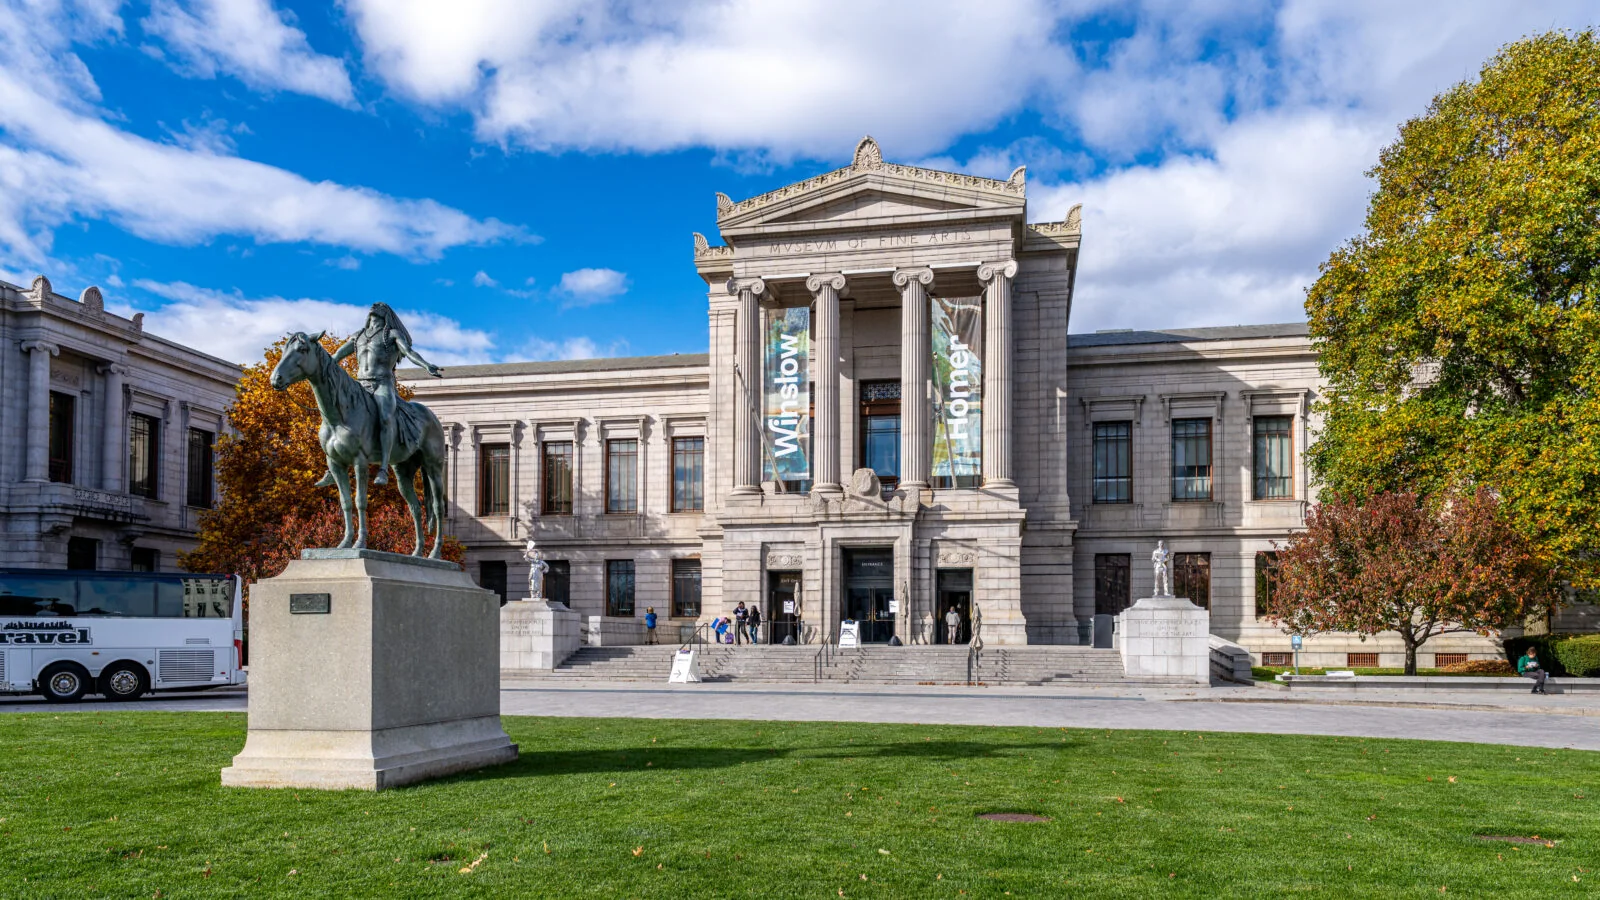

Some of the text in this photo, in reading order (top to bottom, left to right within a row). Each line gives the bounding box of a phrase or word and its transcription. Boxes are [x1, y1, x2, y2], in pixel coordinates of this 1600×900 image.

[769, 230, 973, 255] MVSEVM OF FINE ARTS
[768, 333, 799, 457] Winslow
[944, 334, 969, 441] Homer
[0, 629, 90, 644] ravel
